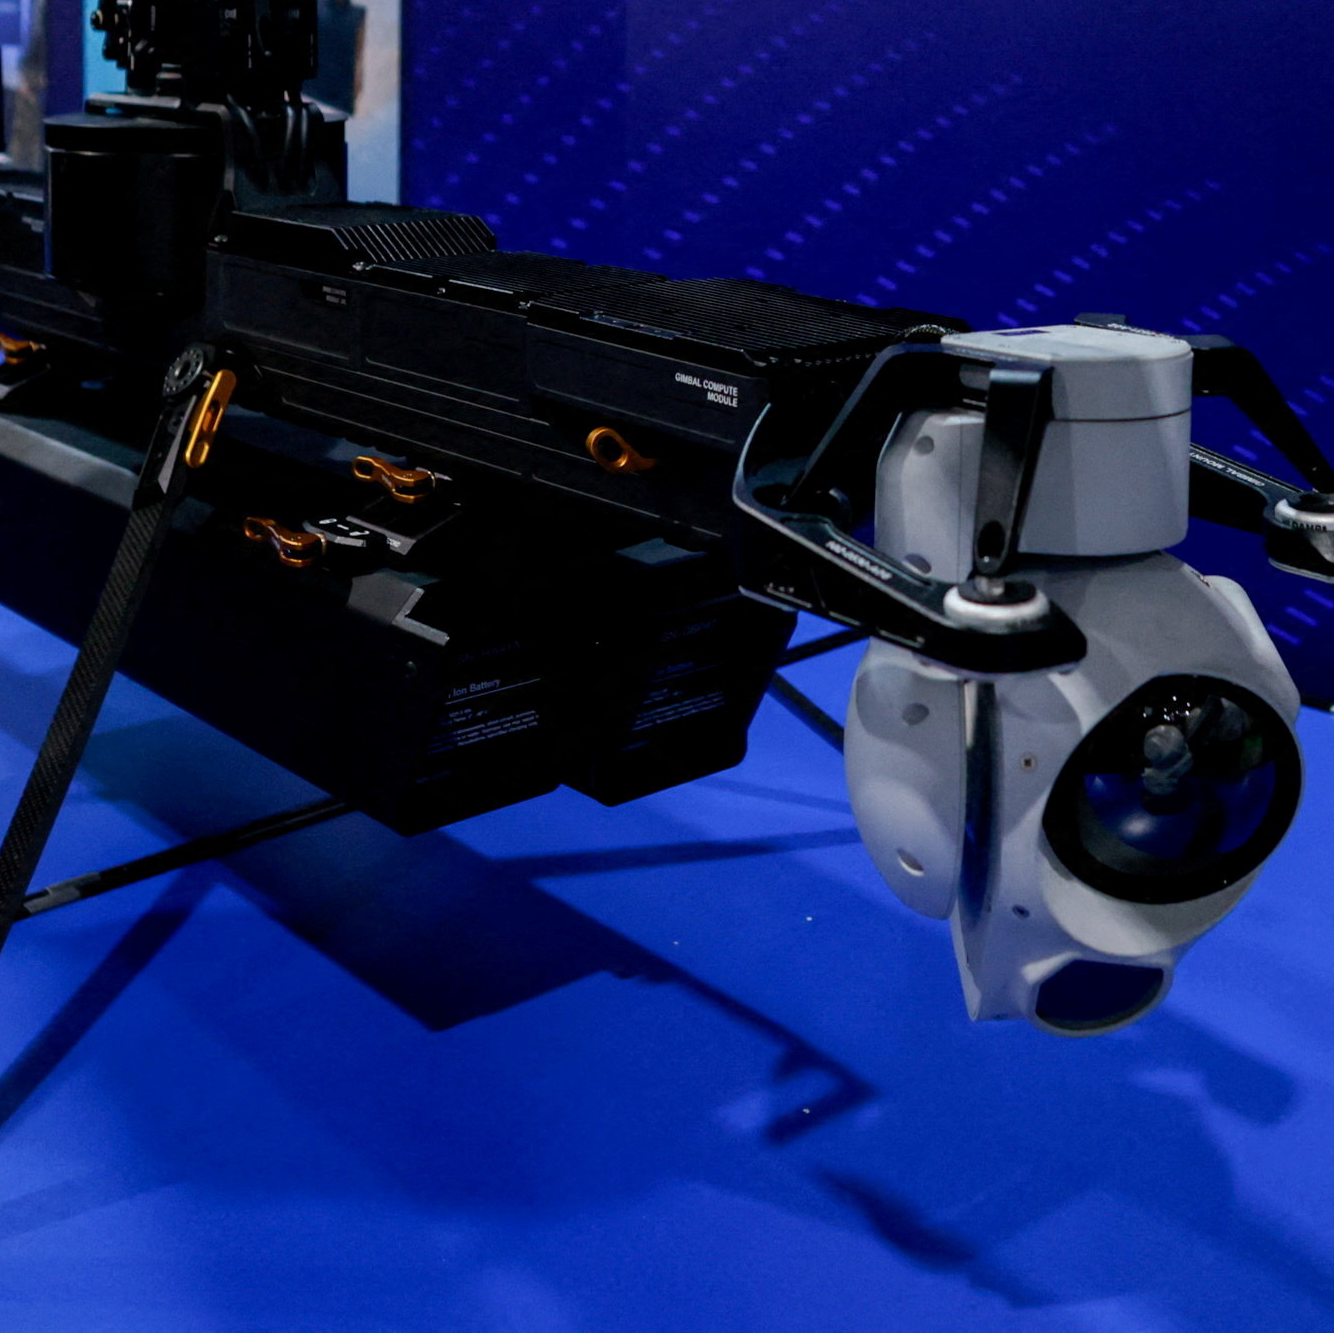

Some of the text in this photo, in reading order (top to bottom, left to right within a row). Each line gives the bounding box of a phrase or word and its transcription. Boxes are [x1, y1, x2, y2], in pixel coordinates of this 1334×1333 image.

[675, 372, 738, 397] GIMBAL COMPUTE
[707, 391, 738, 407] MODULE
